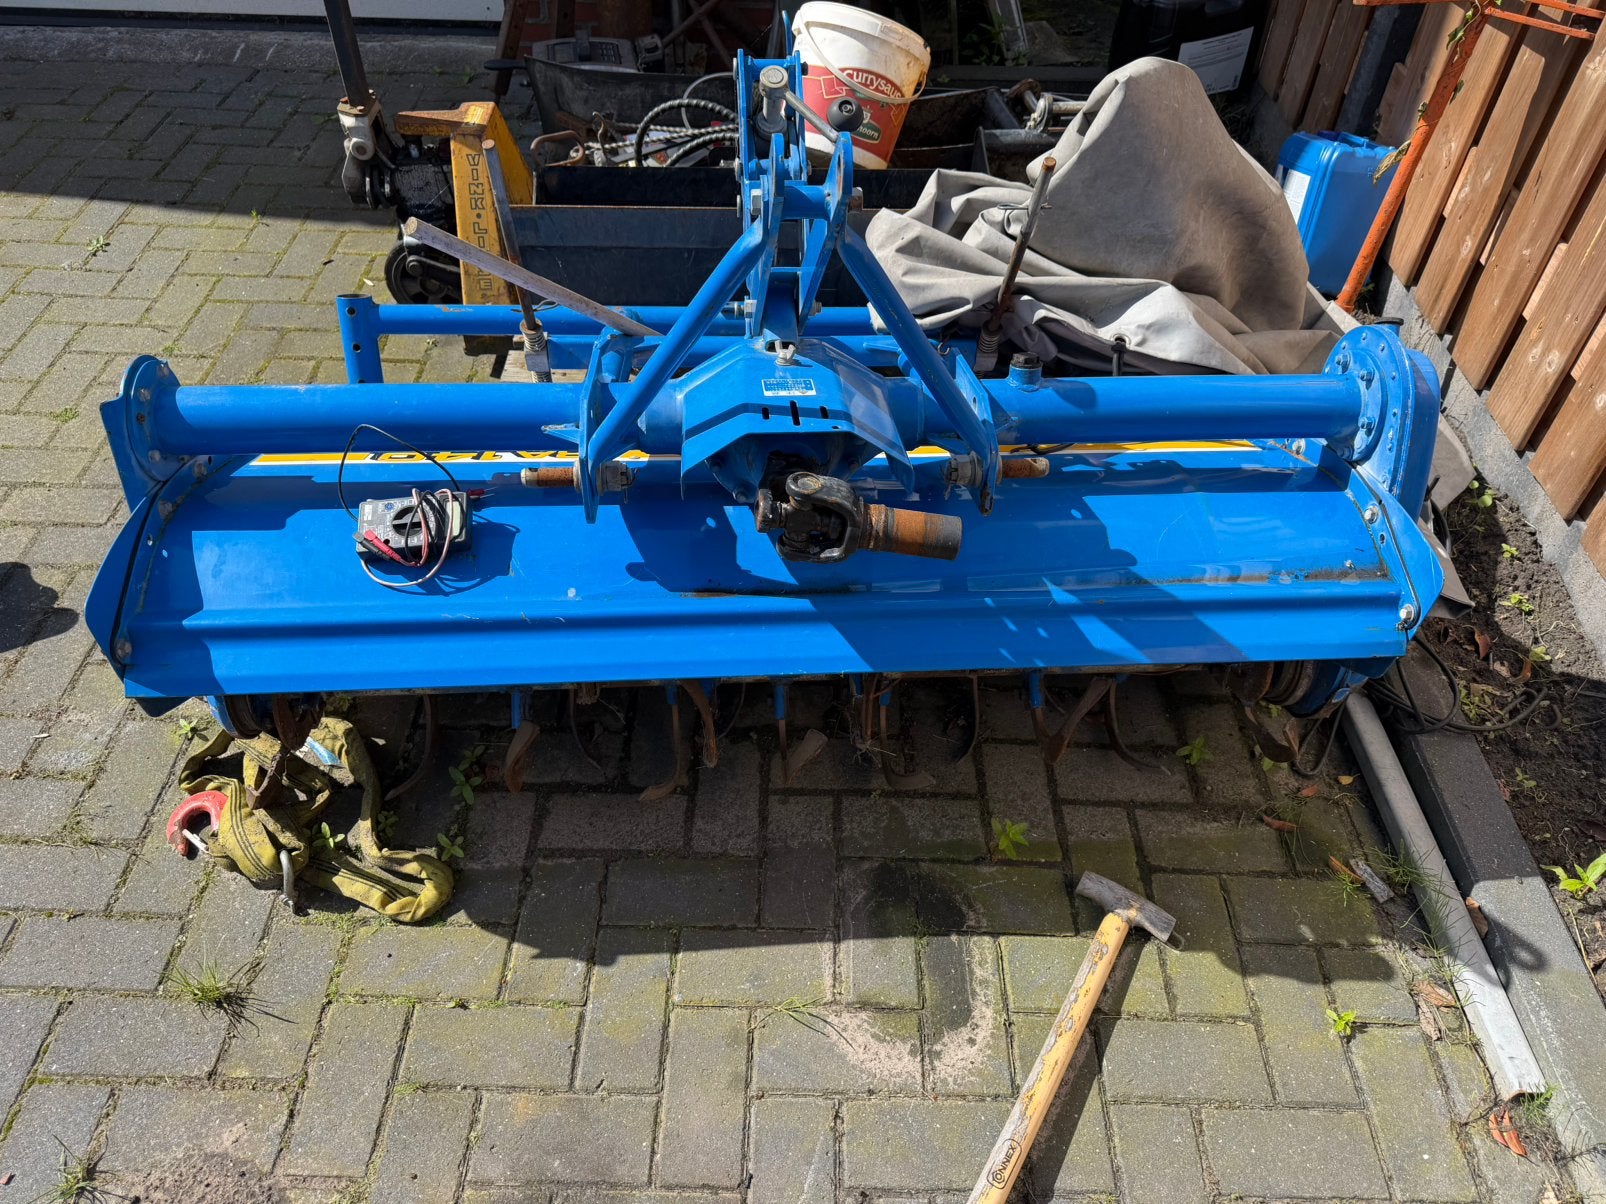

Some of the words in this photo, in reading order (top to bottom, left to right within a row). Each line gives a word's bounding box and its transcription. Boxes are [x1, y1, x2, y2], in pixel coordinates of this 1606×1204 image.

[466, 153, 485, 210] VINK
[473, 222, 493, 290] LIE
[992, 1143, 1017, 1184] CONNEX
